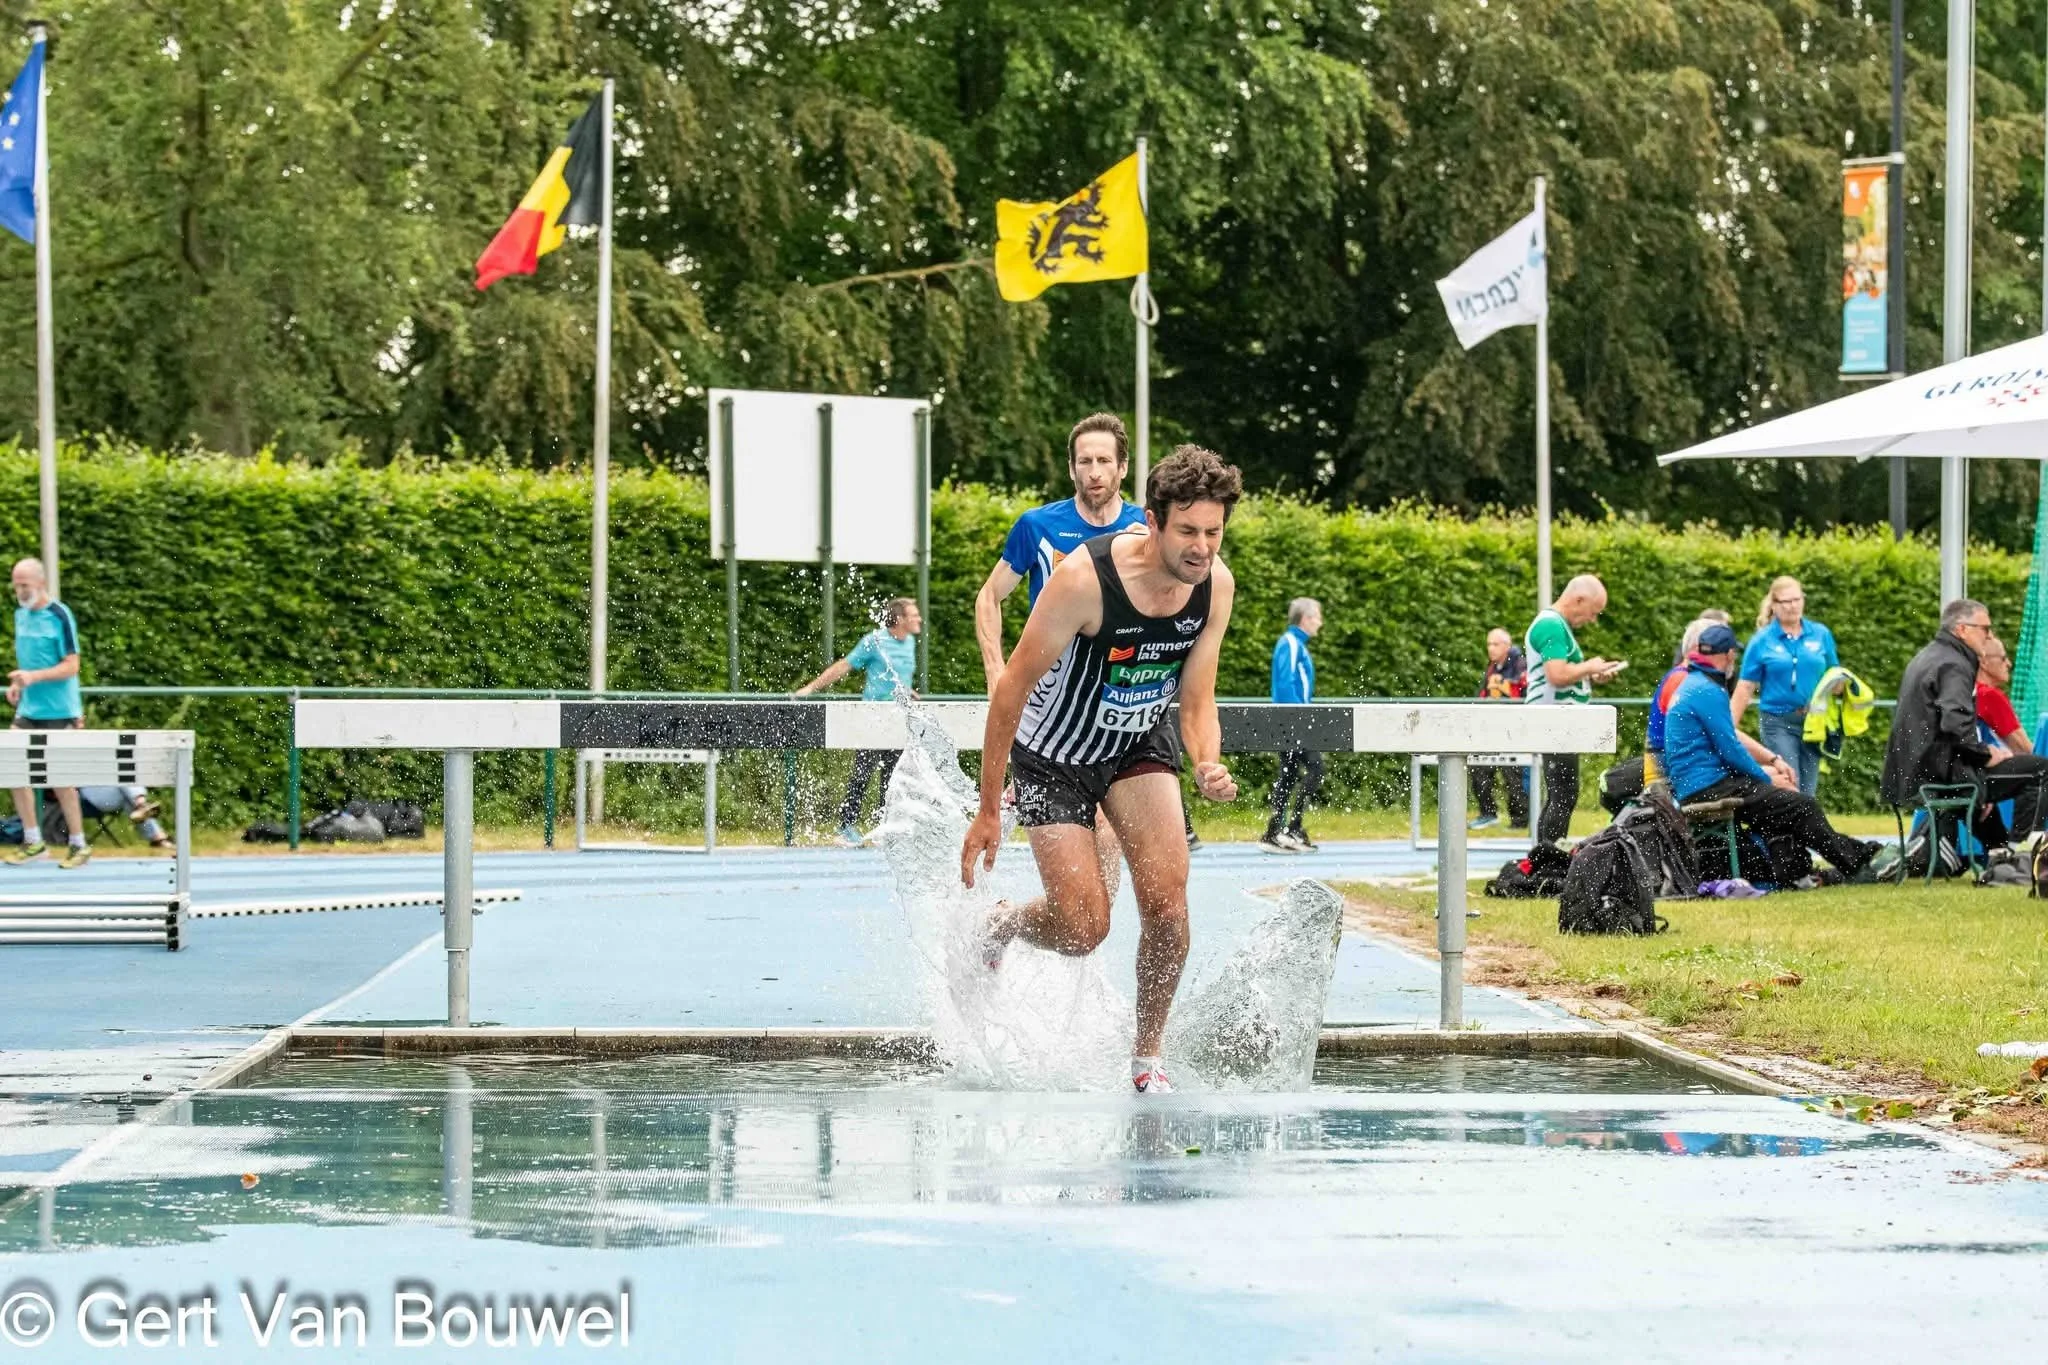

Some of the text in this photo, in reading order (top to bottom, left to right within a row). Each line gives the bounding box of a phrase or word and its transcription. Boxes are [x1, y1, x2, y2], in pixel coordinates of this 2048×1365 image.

[1137, 651, 1160, 661] lab
[1108, 689, 1160, 703] Allianz
[1103, 704, 1162, 727] 6718
